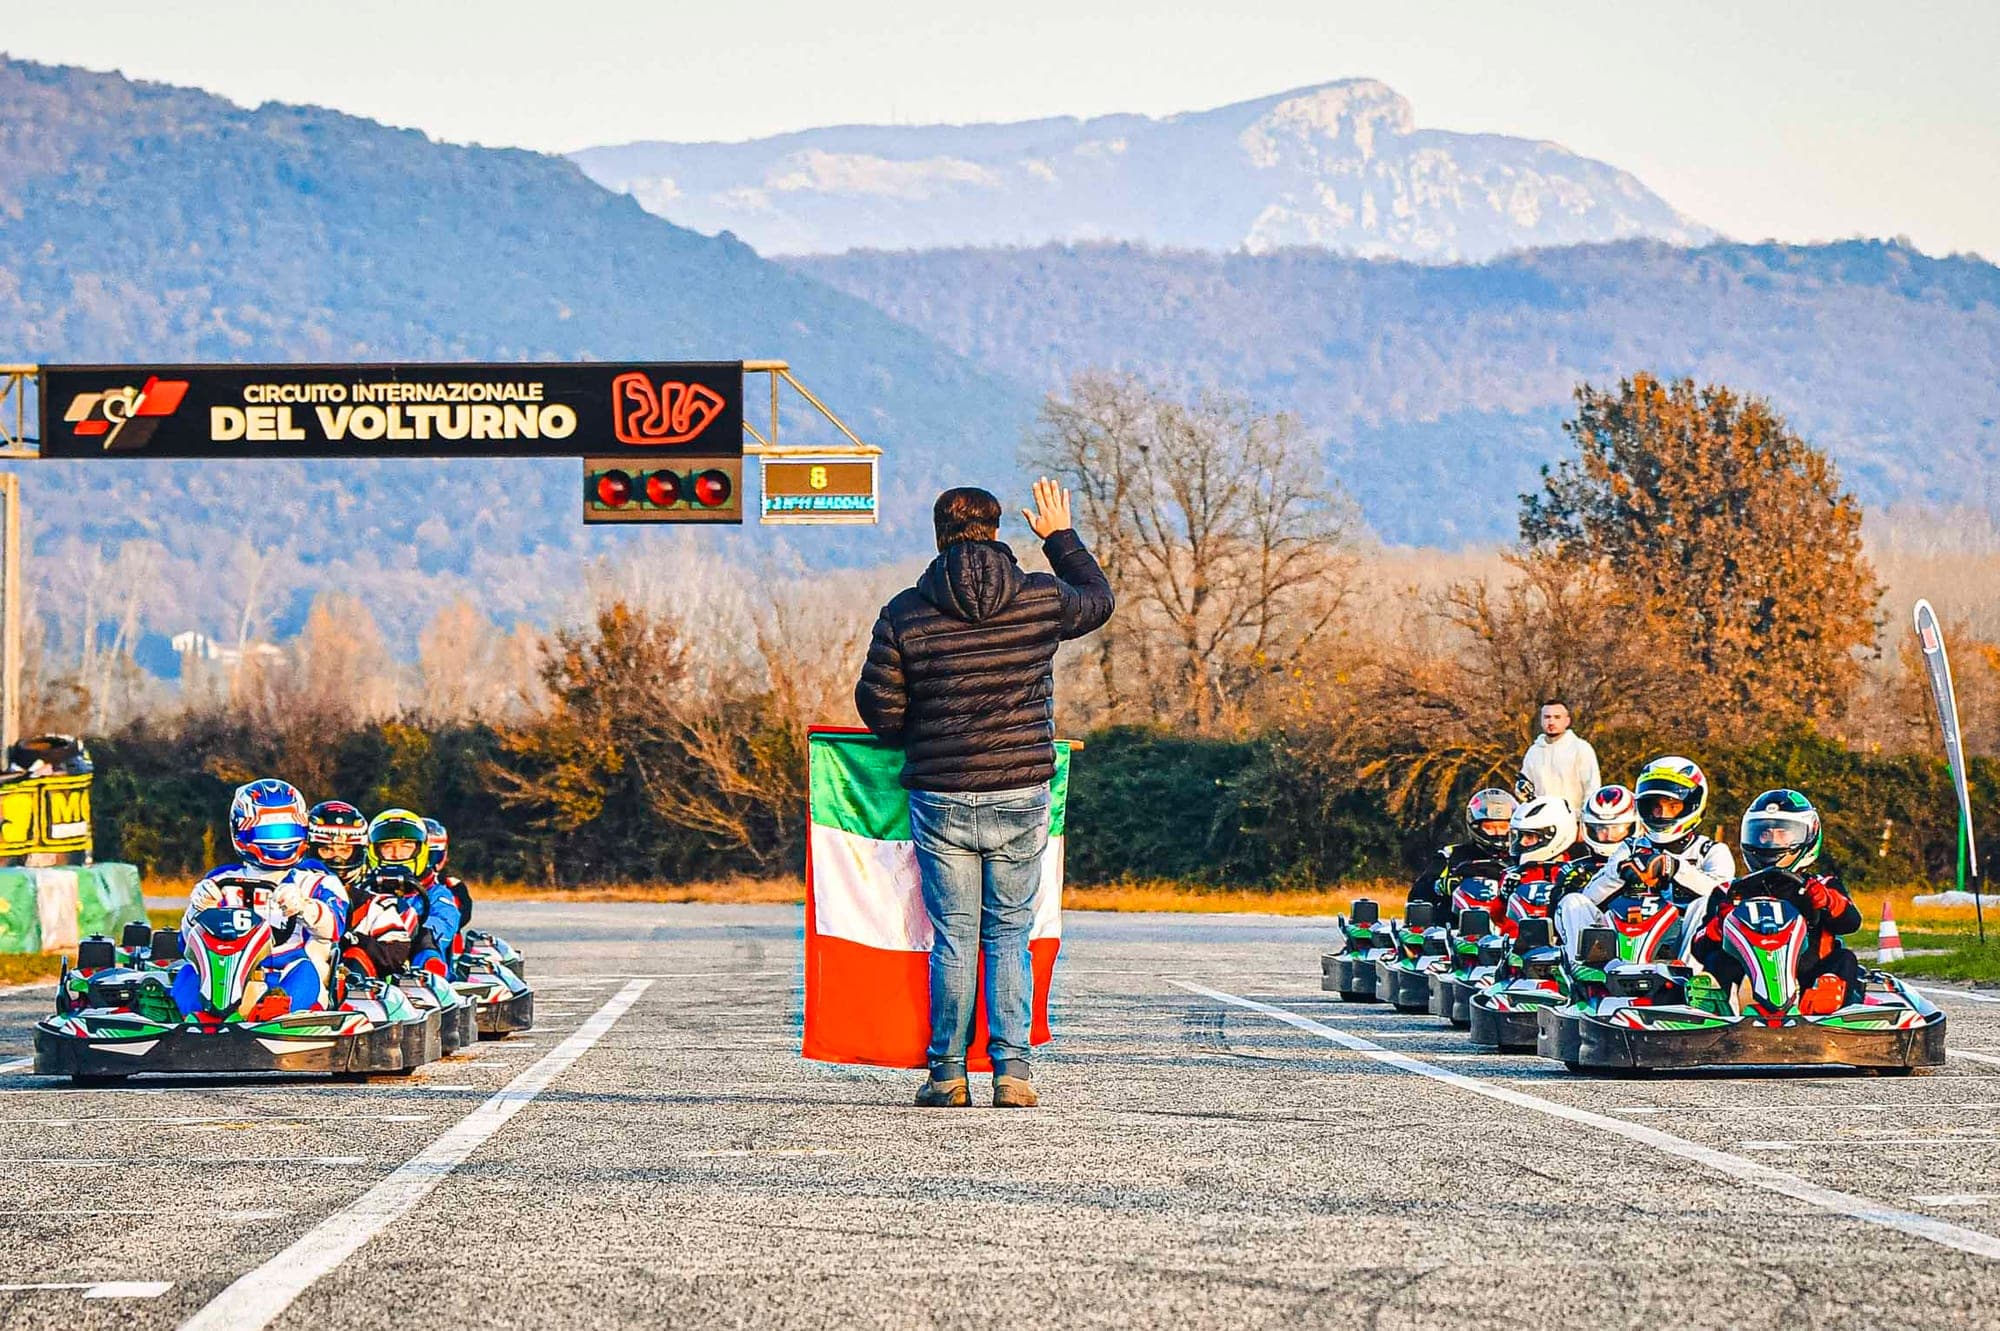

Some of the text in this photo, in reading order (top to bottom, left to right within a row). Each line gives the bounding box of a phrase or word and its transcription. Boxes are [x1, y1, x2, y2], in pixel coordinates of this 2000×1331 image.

[243, 383, 544, 403] CIRCUITO INTERNAZIONALE
[210, 403, 577, 441] DEL VOLTURNO
[810, 465, 828, 490] 8
[1484, 879, 1498, 898] 3
[1641, 896, 1660, 916] 5
[1745, 901, 1784, 924] 11
[233, 909, 252, 931] 6
